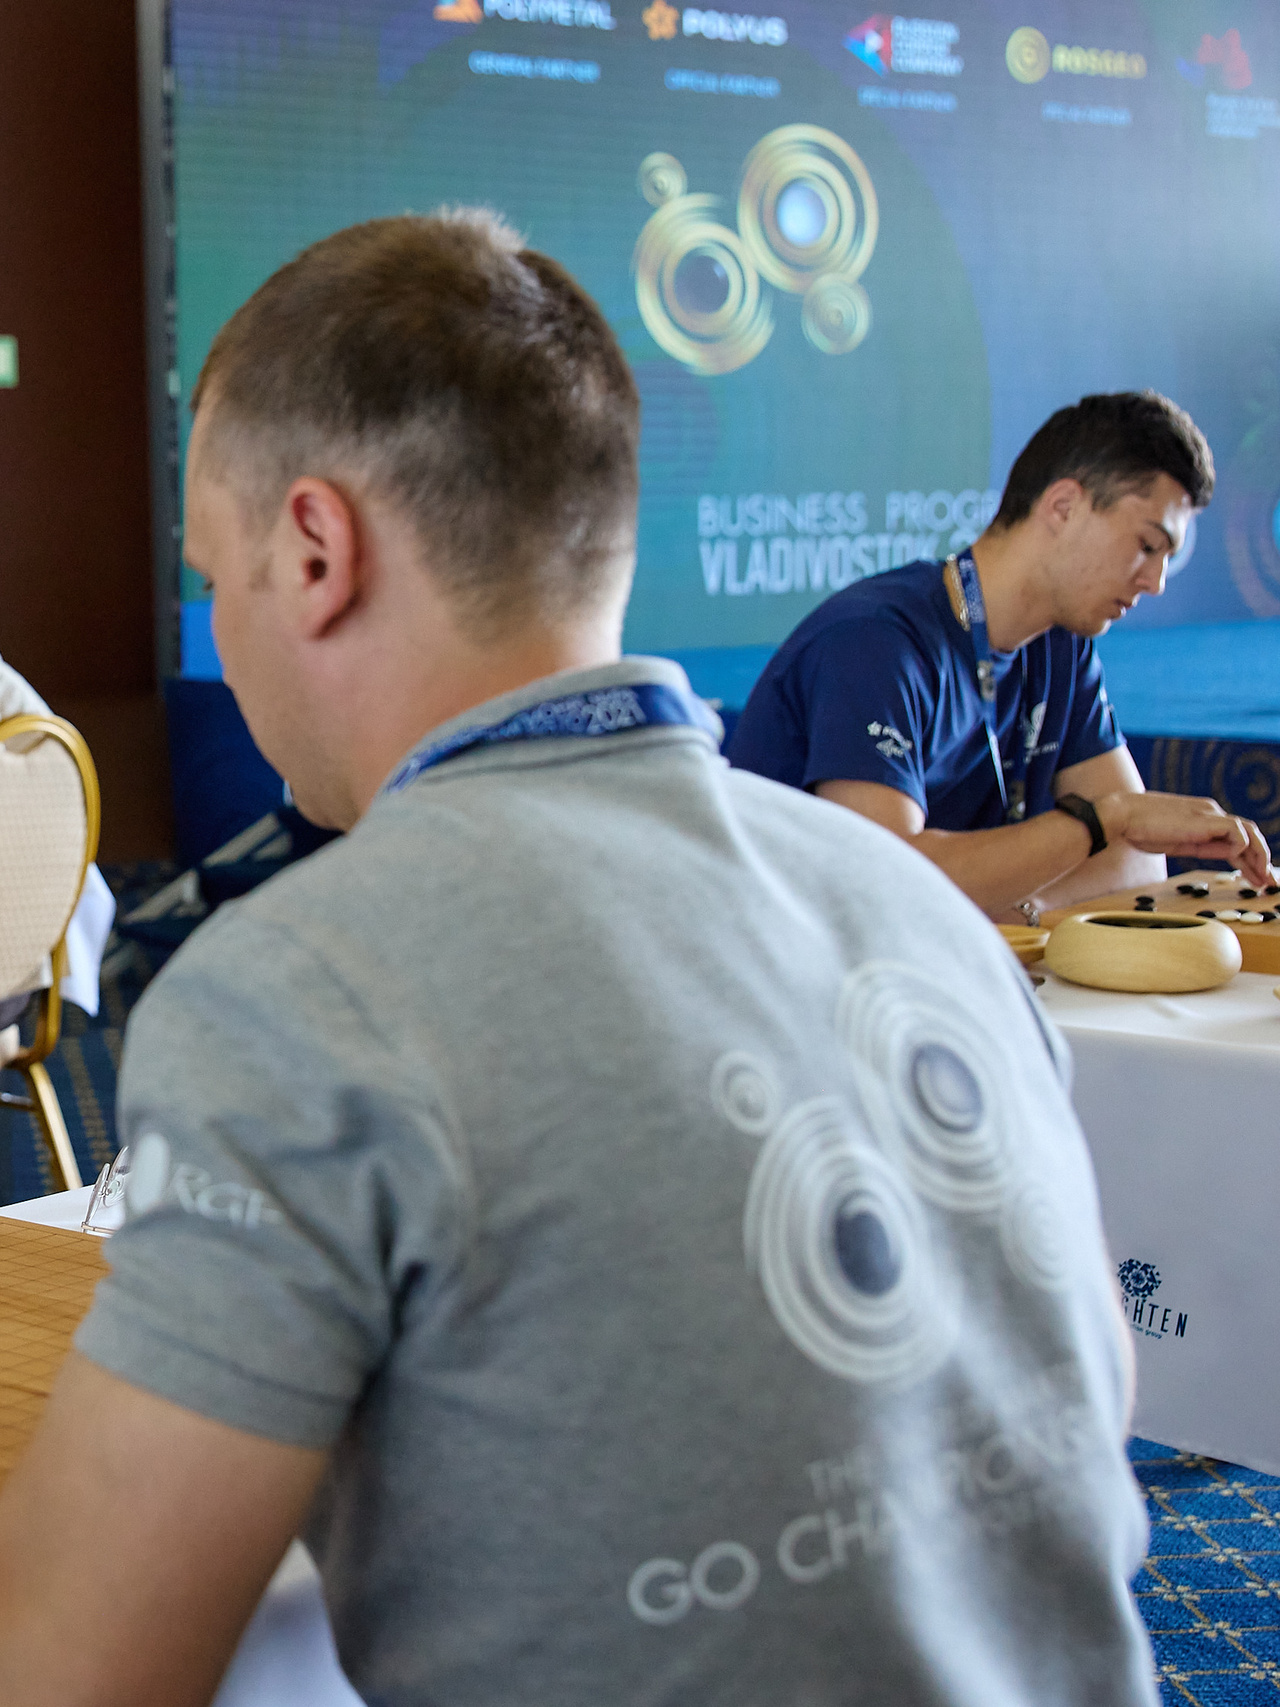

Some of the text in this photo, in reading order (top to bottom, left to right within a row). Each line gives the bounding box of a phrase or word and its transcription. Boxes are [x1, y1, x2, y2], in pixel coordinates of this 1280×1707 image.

[682, 8, 788, 46] POLYUS
[698, 491, 869, 537] BUSINESS
[627, 1541, 760, 1624] GO
